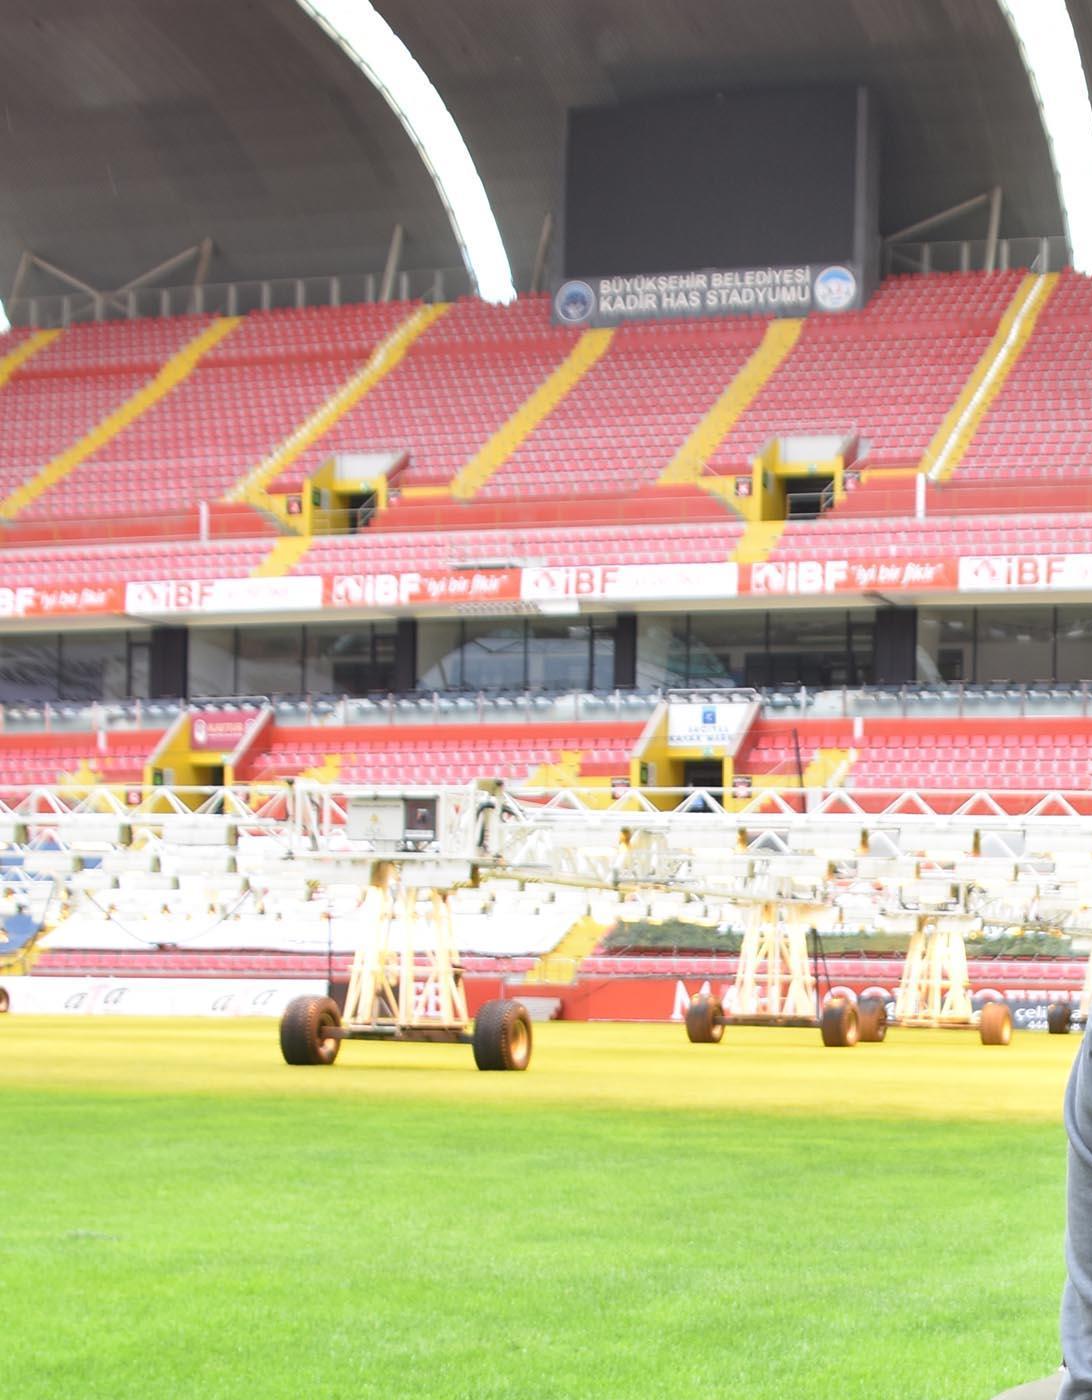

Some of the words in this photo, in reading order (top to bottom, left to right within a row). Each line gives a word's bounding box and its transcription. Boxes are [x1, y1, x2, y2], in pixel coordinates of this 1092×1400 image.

[600, 272, 707, 294] BÜYÜKŞEHİR
[711, 266, 810, 288] BELEDİYESİ
[600, 290, 657, 311] KADİR
[662, 289, 700, 309] HAS
[706, 286, 810, 305] STADYUMU
